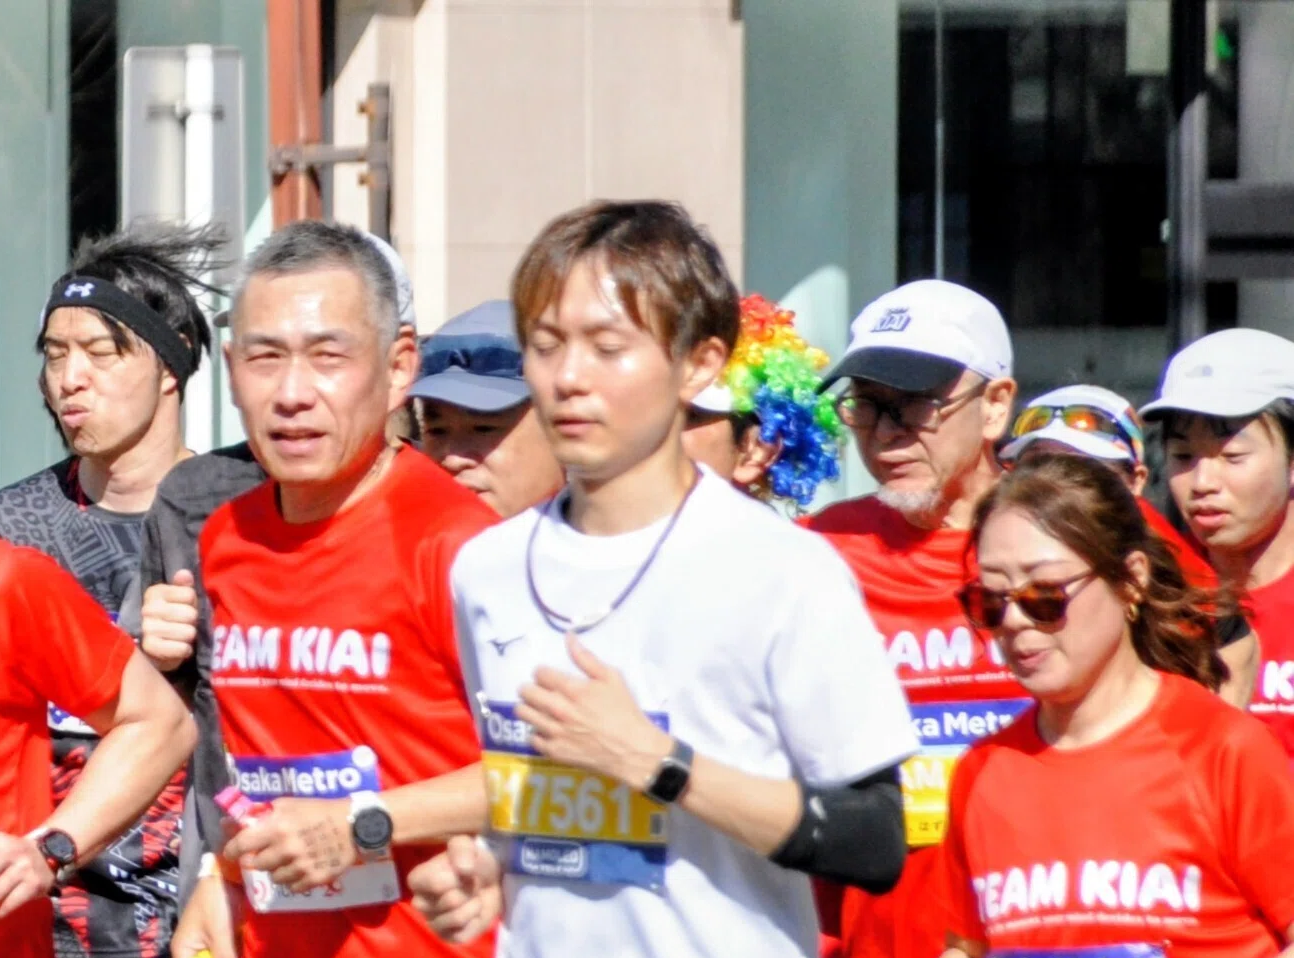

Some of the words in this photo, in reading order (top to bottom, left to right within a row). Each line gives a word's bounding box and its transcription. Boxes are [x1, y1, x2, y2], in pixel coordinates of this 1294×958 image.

[290, 625, 392, 678] KIAI
[283, 766, 362, 794] Metro
[973, 861, 1067, 923] TEAM
[1081, 860, 1202, 911] KIAI
